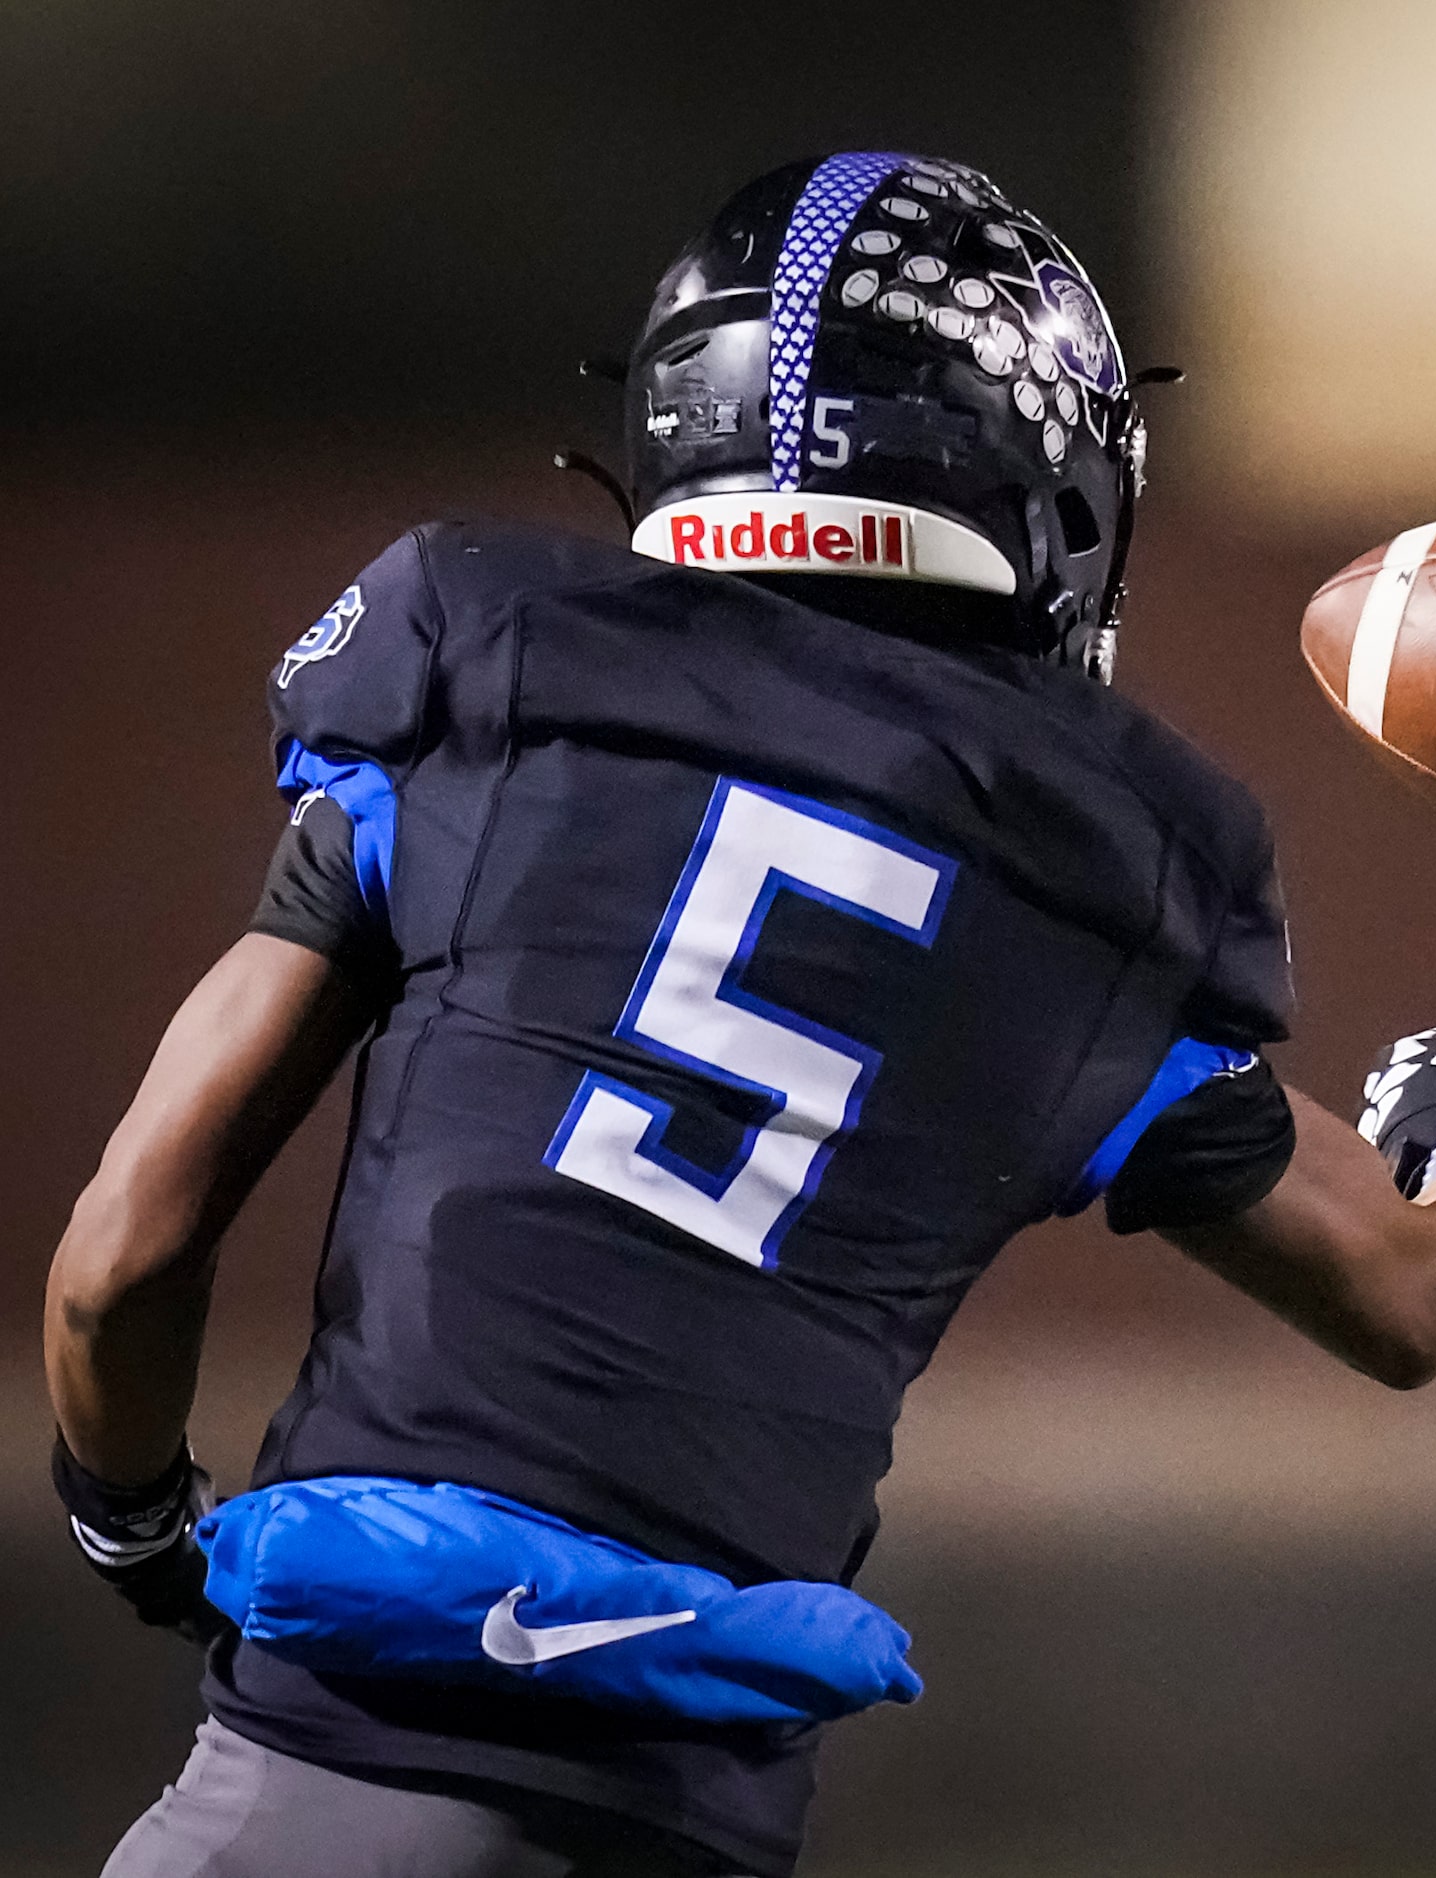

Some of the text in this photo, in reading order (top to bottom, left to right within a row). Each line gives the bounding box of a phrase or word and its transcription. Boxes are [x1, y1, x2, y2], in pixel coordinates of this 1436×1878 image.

[809, 396, 855, 470] 5
[671, 510, 904, 566] Riddell
[541, 774, 961, 1272] 5
